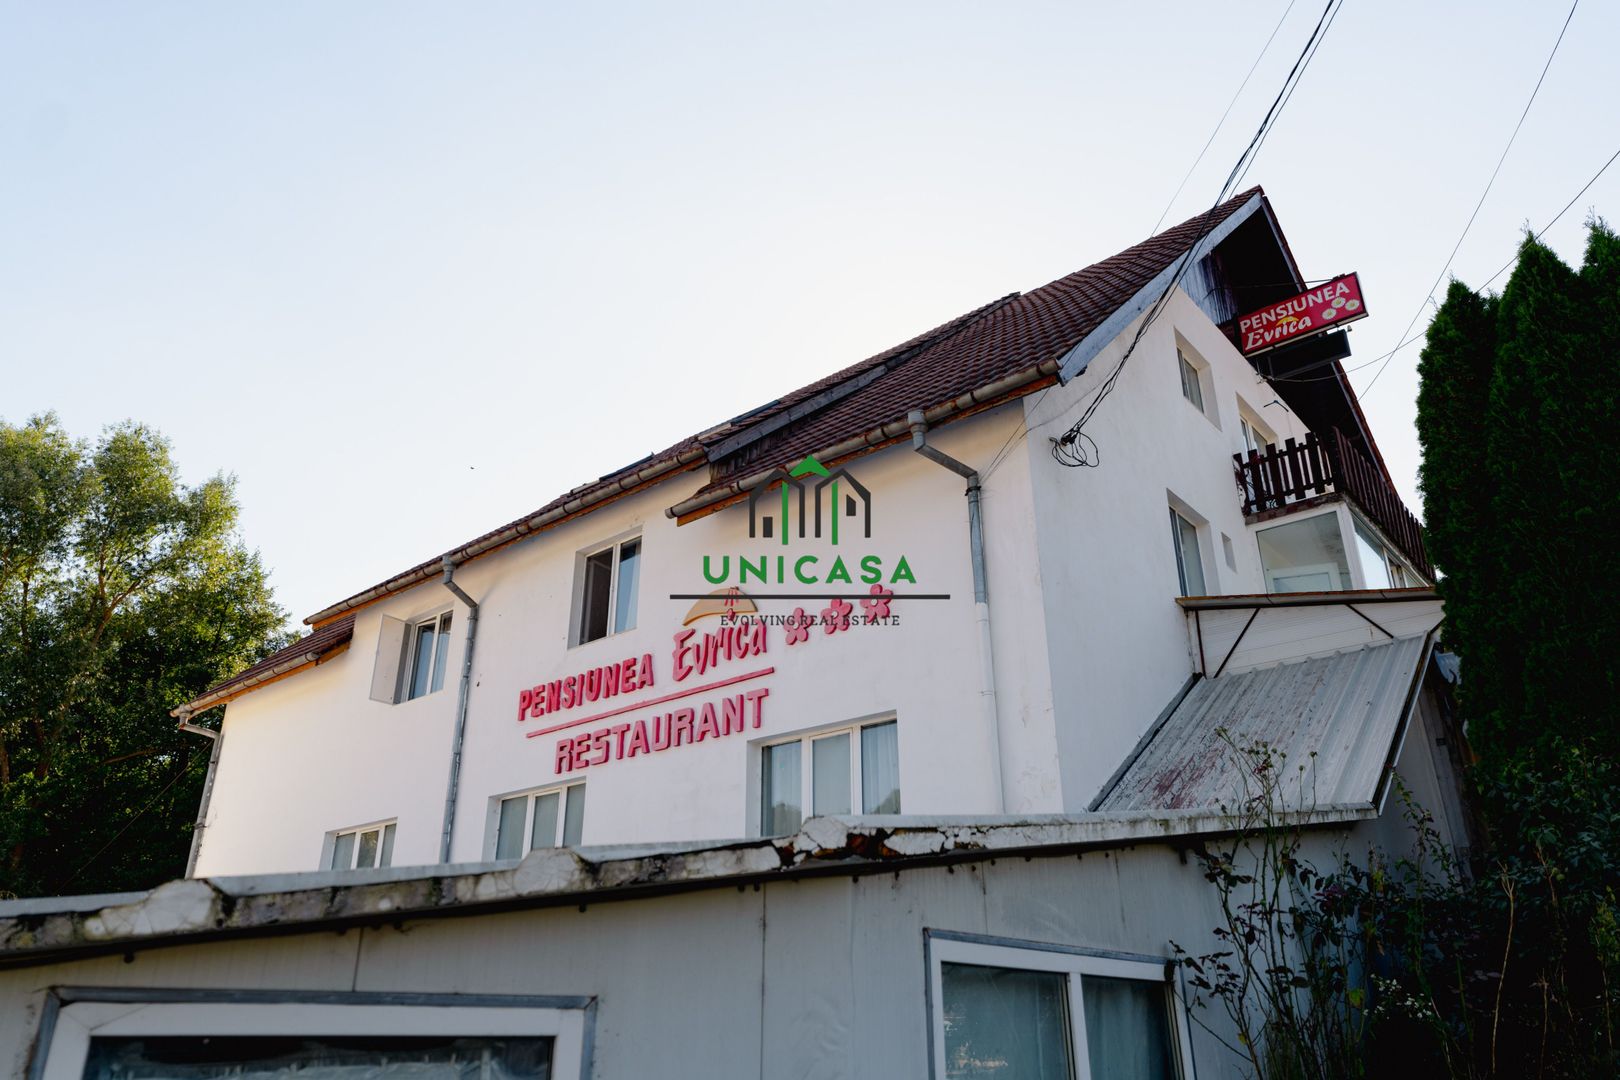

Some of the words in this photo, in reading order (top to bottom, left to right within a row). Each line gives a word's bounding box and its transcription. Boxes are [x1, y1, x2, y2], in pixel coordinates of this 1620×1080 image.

[1240, 282, 1350, 333] PENSIUNEA
[1245, 316, 1312, 350] Evrica
[518, 654, 655, 721] PENSIUNEA
[672, 612, 768, 682] Evrica
[555, 688, 769, 774] RESTAURANT
